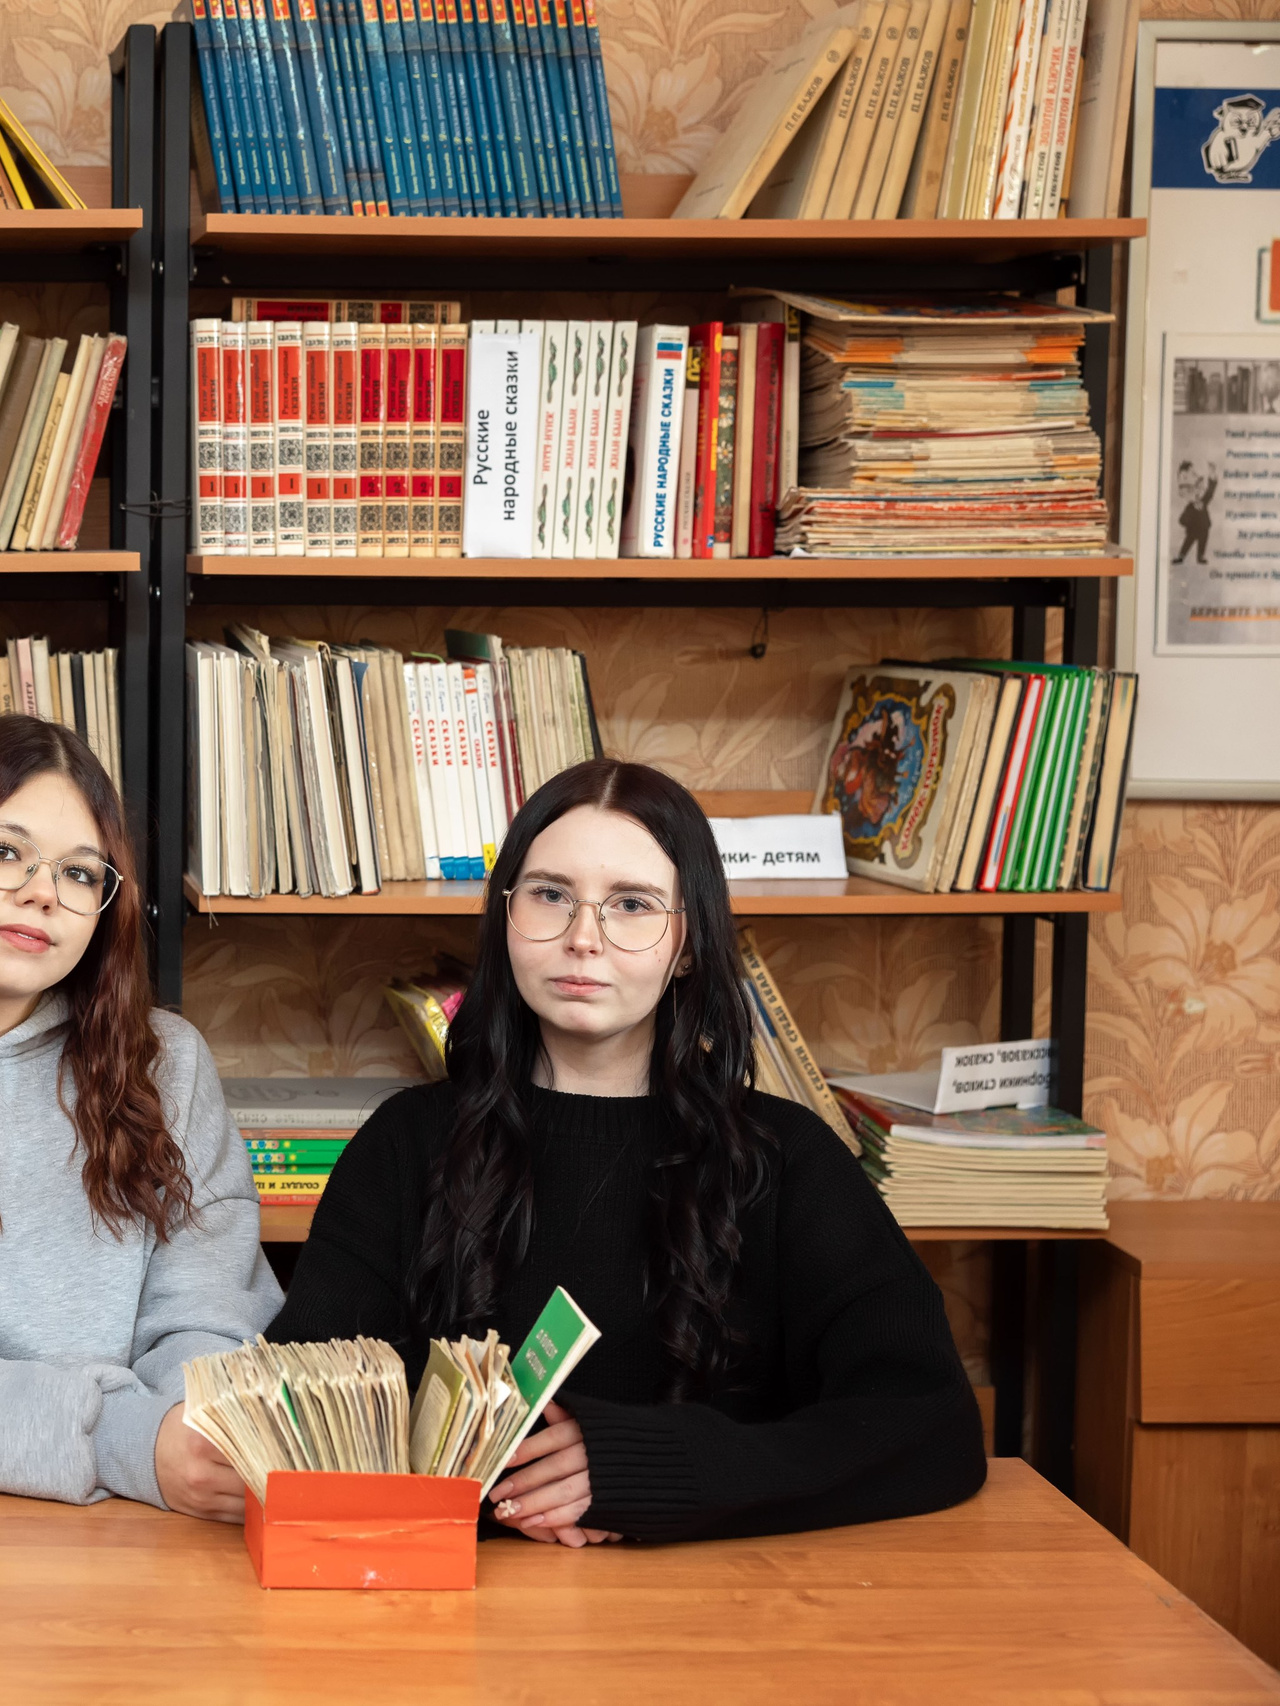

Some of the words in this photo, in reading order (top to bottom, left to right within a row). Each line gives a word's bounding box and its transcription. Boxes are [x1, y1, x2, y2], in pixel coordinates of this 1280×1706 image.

[1045, 45, 1062, 94] КЛЮЧИК
[1061, 45, 1077, 93] КЛЮЧИК
[1038, 97, 1055, 146] ЗОЛОТОЙ
[1054, 96, 1071, 146] ЗОЛОТОЙ
[505, 350, 518, 414] сказки
[660, 367, 674, 417] СКАЗКИ
[473, 409, 491, 484] Русские
[503, 421, 519, 520] народные
[656, 420, 672, 488] НАРОДНЫЕ
[652, 492, 666, 547] РУССКИЕ
[762, 852, 821, 866] детям
[754, 971, 778, 1005] БЕЛА
[772, 1005, 800, 1044] СРЕДИ
[793, 1045, 825, 1092] СКАЗКИ
[954, 1052, 994, 1068] сказок
